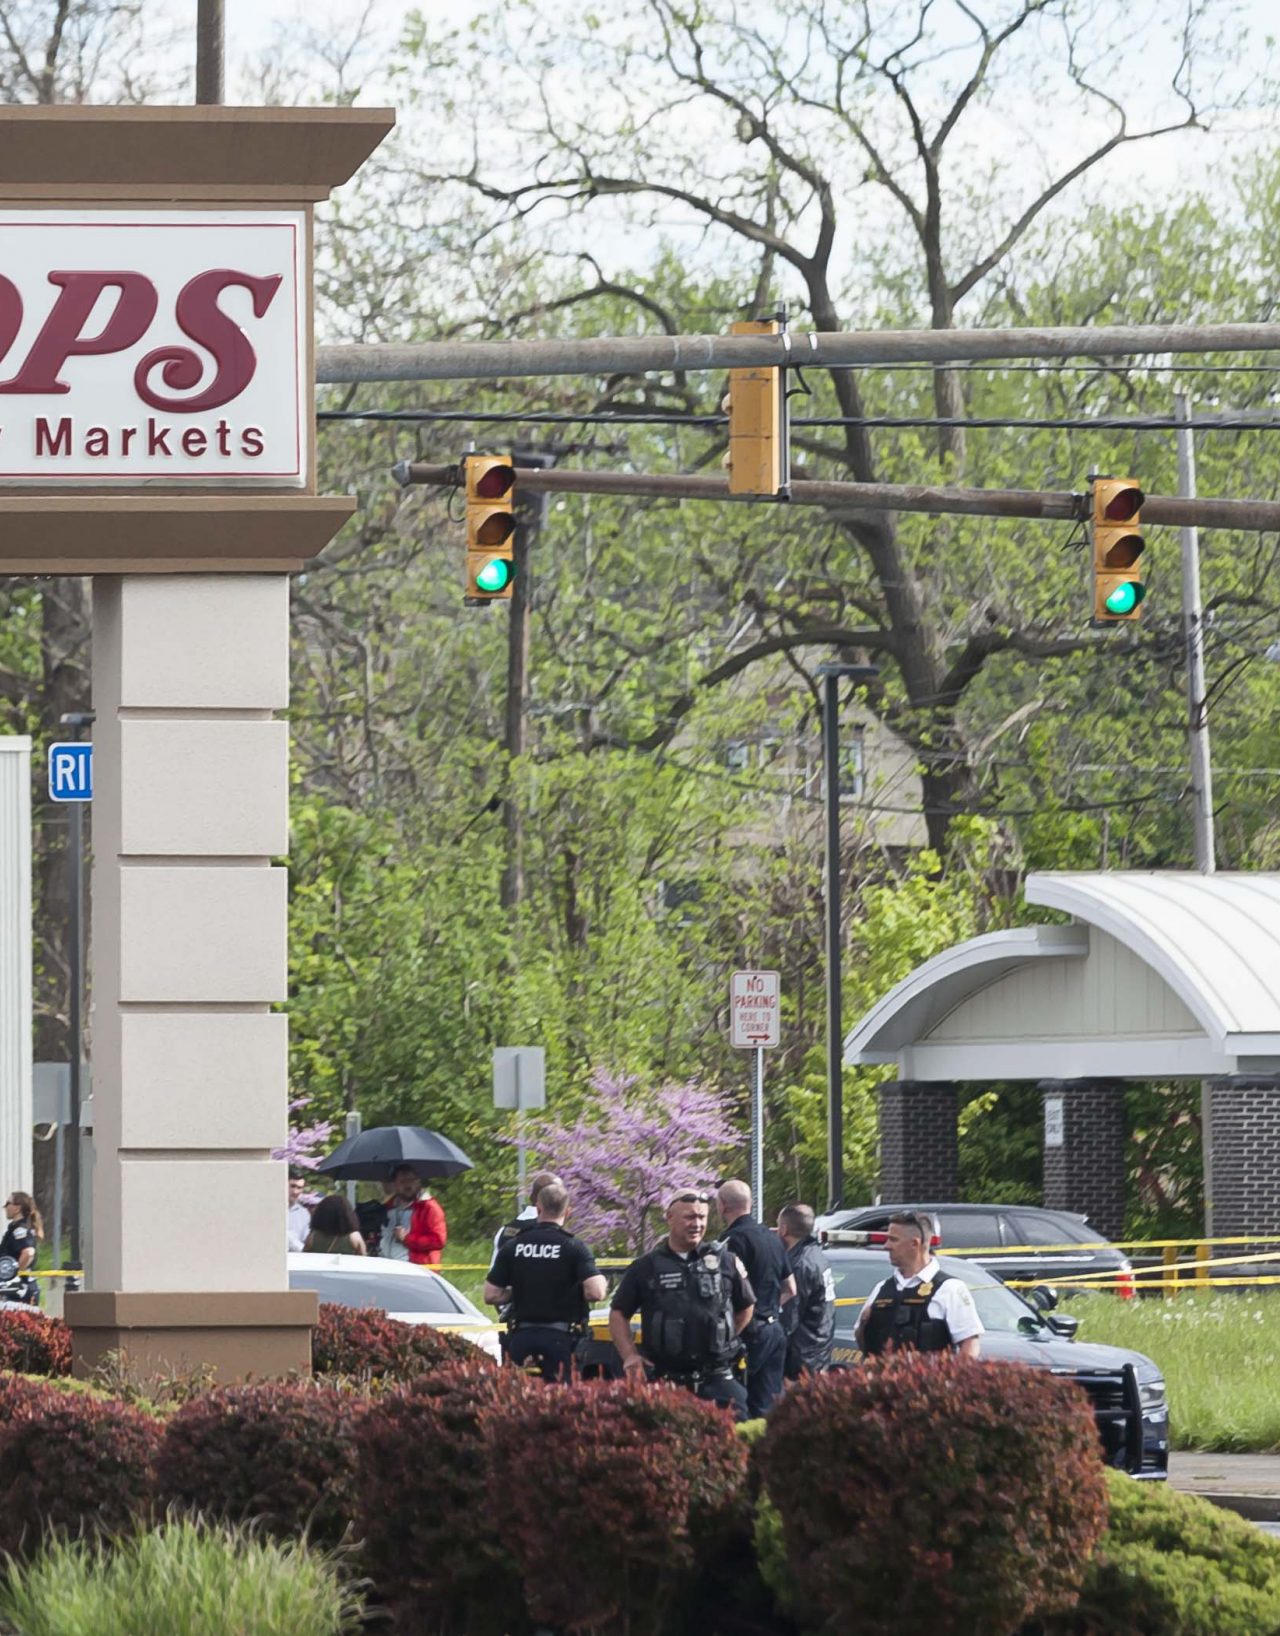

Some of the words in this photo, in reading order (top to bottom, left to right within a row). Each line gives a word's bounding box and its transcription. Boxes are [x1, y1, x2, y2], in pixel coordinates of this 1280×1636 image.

[35, 417, 265, 458] Markets
[746, 978, 764, 992] NO
[734, 994, 776, 1009] PARKING
[740, 1012, 757, 1021] HERE
[763, 1012, 771, 1021] TO
[741, 1023, 769, 1032] CORNER
[514, 1243, 561, 1258] POLICE
